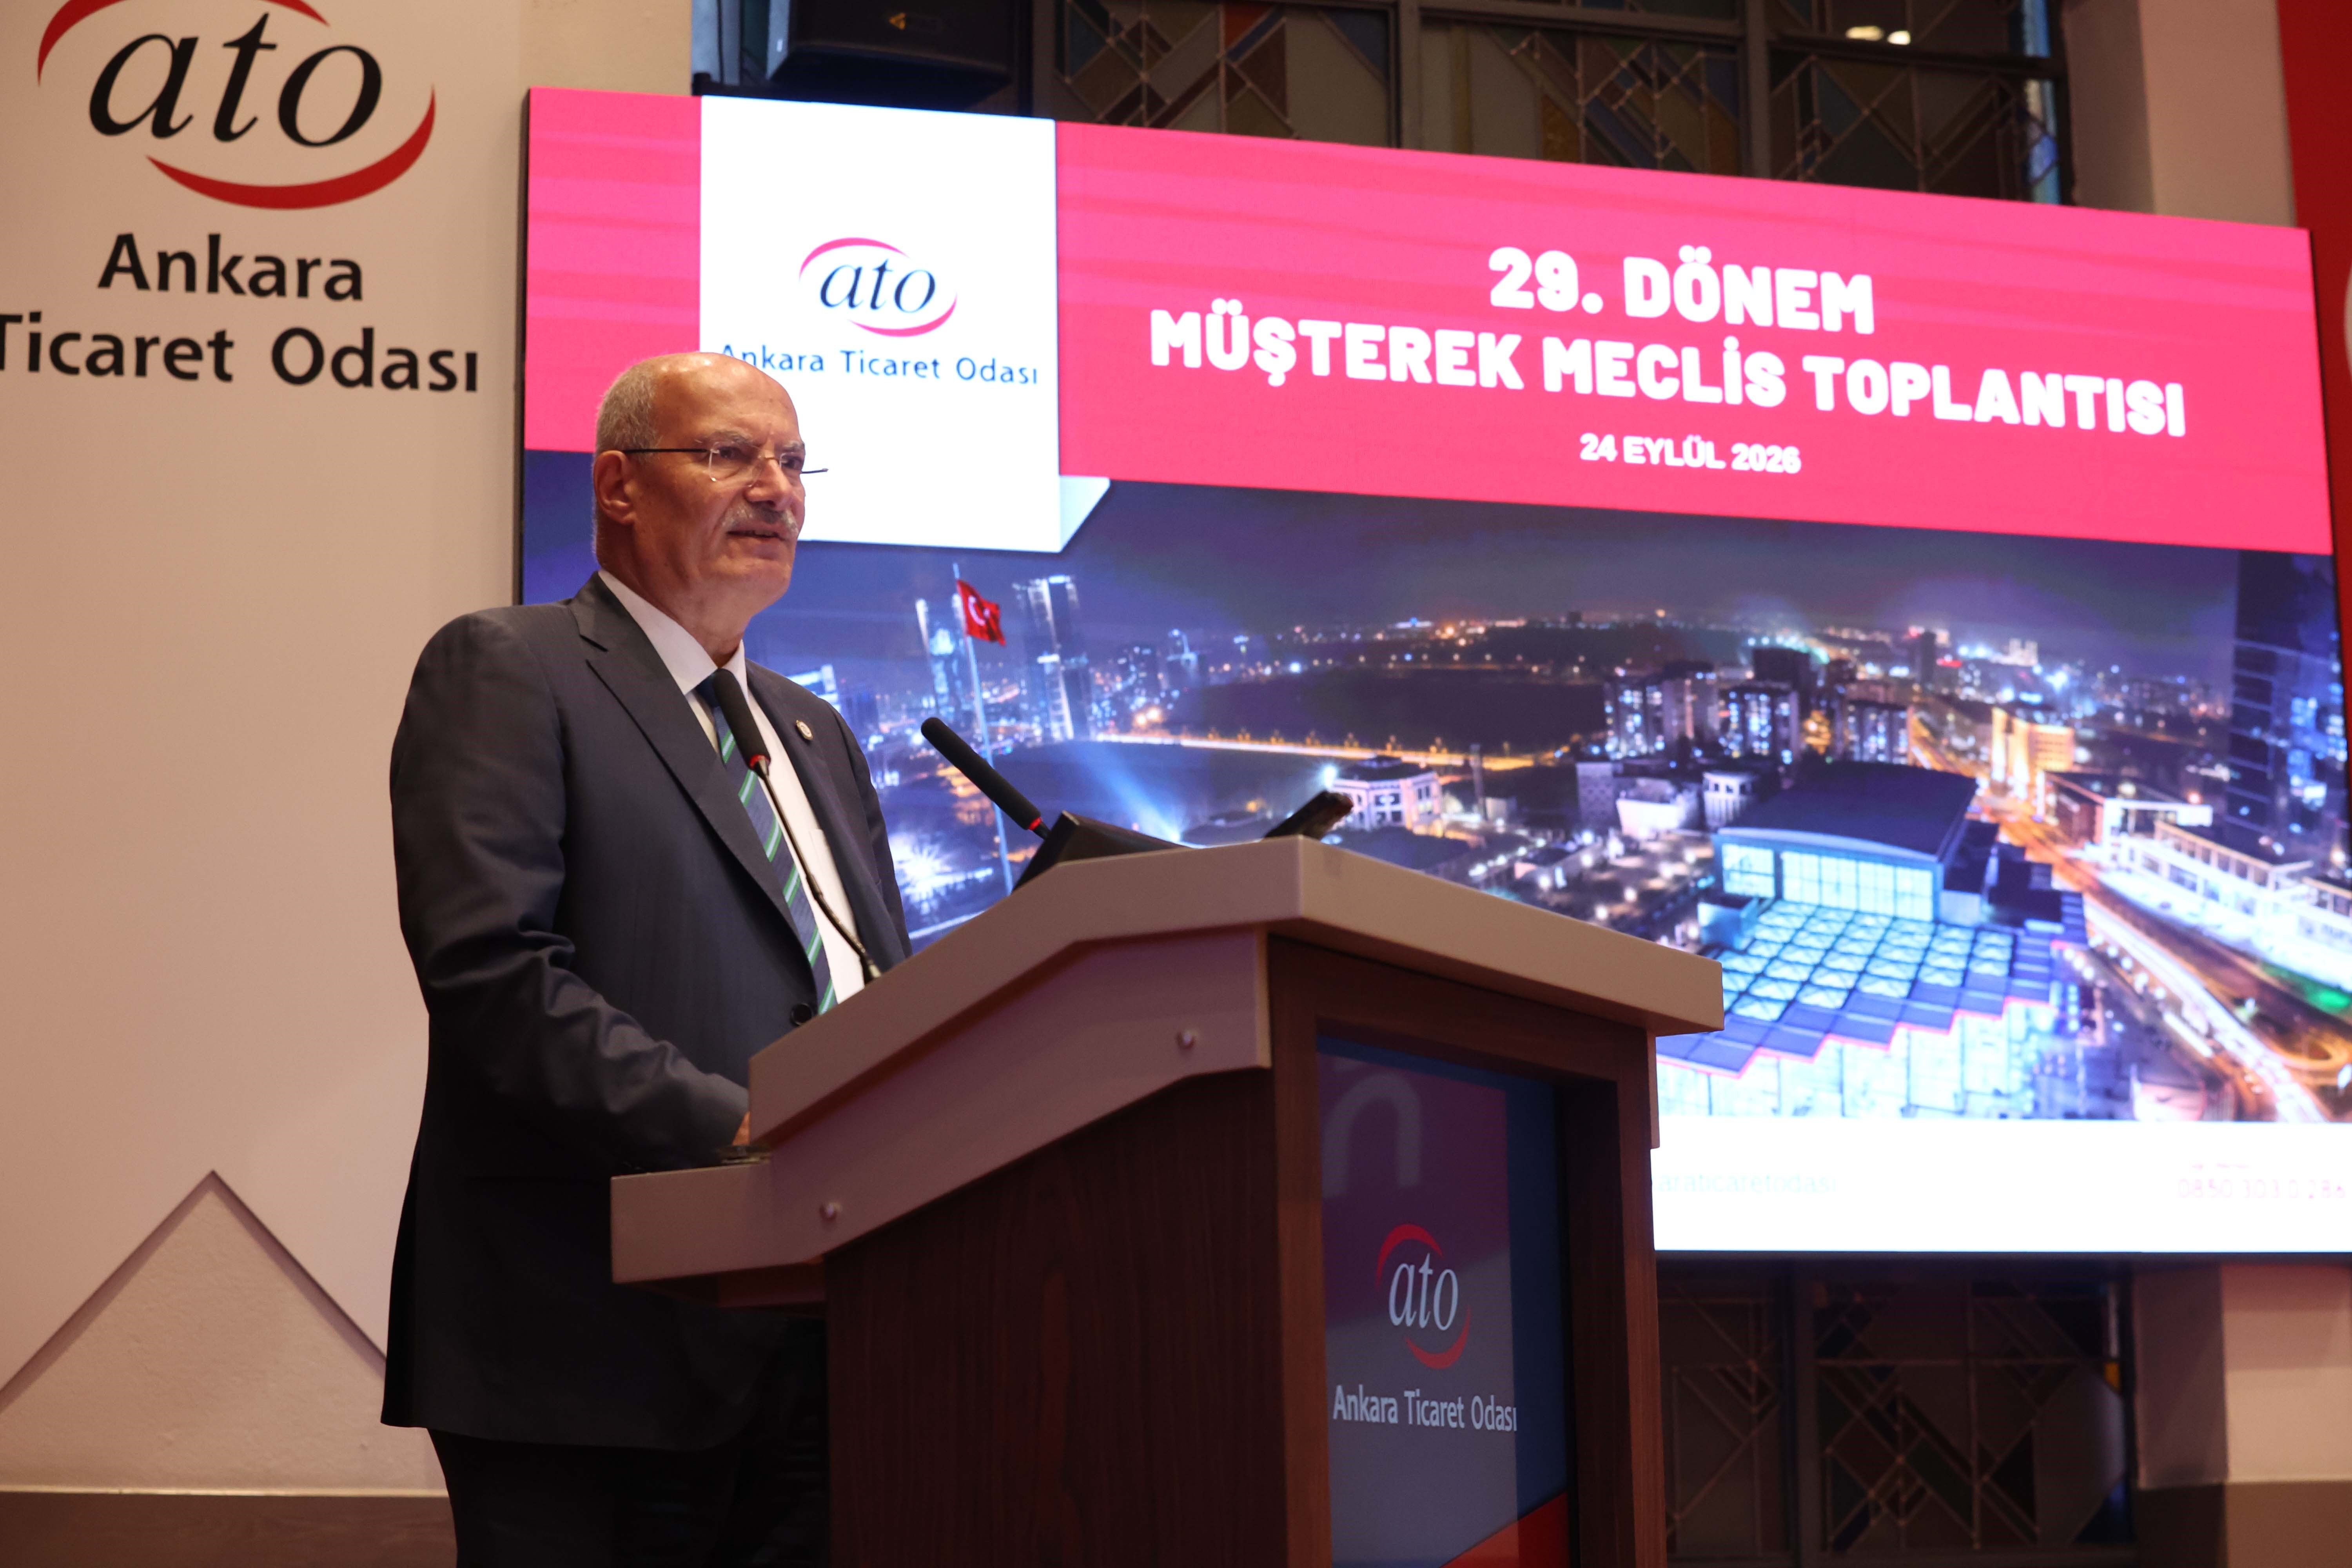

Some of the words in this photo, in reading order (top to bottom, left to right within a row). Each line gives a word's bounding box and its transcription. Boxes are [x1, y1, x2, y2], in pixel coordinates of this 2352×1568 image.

[90, 14, 381, 147] ato
[98, 234, 361, 300] Ankara
[820, 260, 935, 312] ato
[1489, 247, 1603, 314] 29.
[1624, 245, 1874, 334] DÖNEM
[272, 328, 477, 391] Odası
[841, 350, 939, 378] Ticaret
[956, 358, 1036, 383] Odası
[1151, 298, 1524, 390] MÜŞTEREK
[1543, 336, 1786, 407] MECLİS
[1802, 356, 2185, 436] TOPLANTISI
[1581, 433, 1617, 461] 24
[1623, 435, 1726, 469] EYLÜL
[1731, 443, 1801, 474] 2026
[1389, 1253, 1458, 1331] ato
[1334, 1385, 1398, 1423] Ankara
[1404, 1389, 1465, 1428] Ticaret
[1471, 1395, 1517, 1431] Odası
